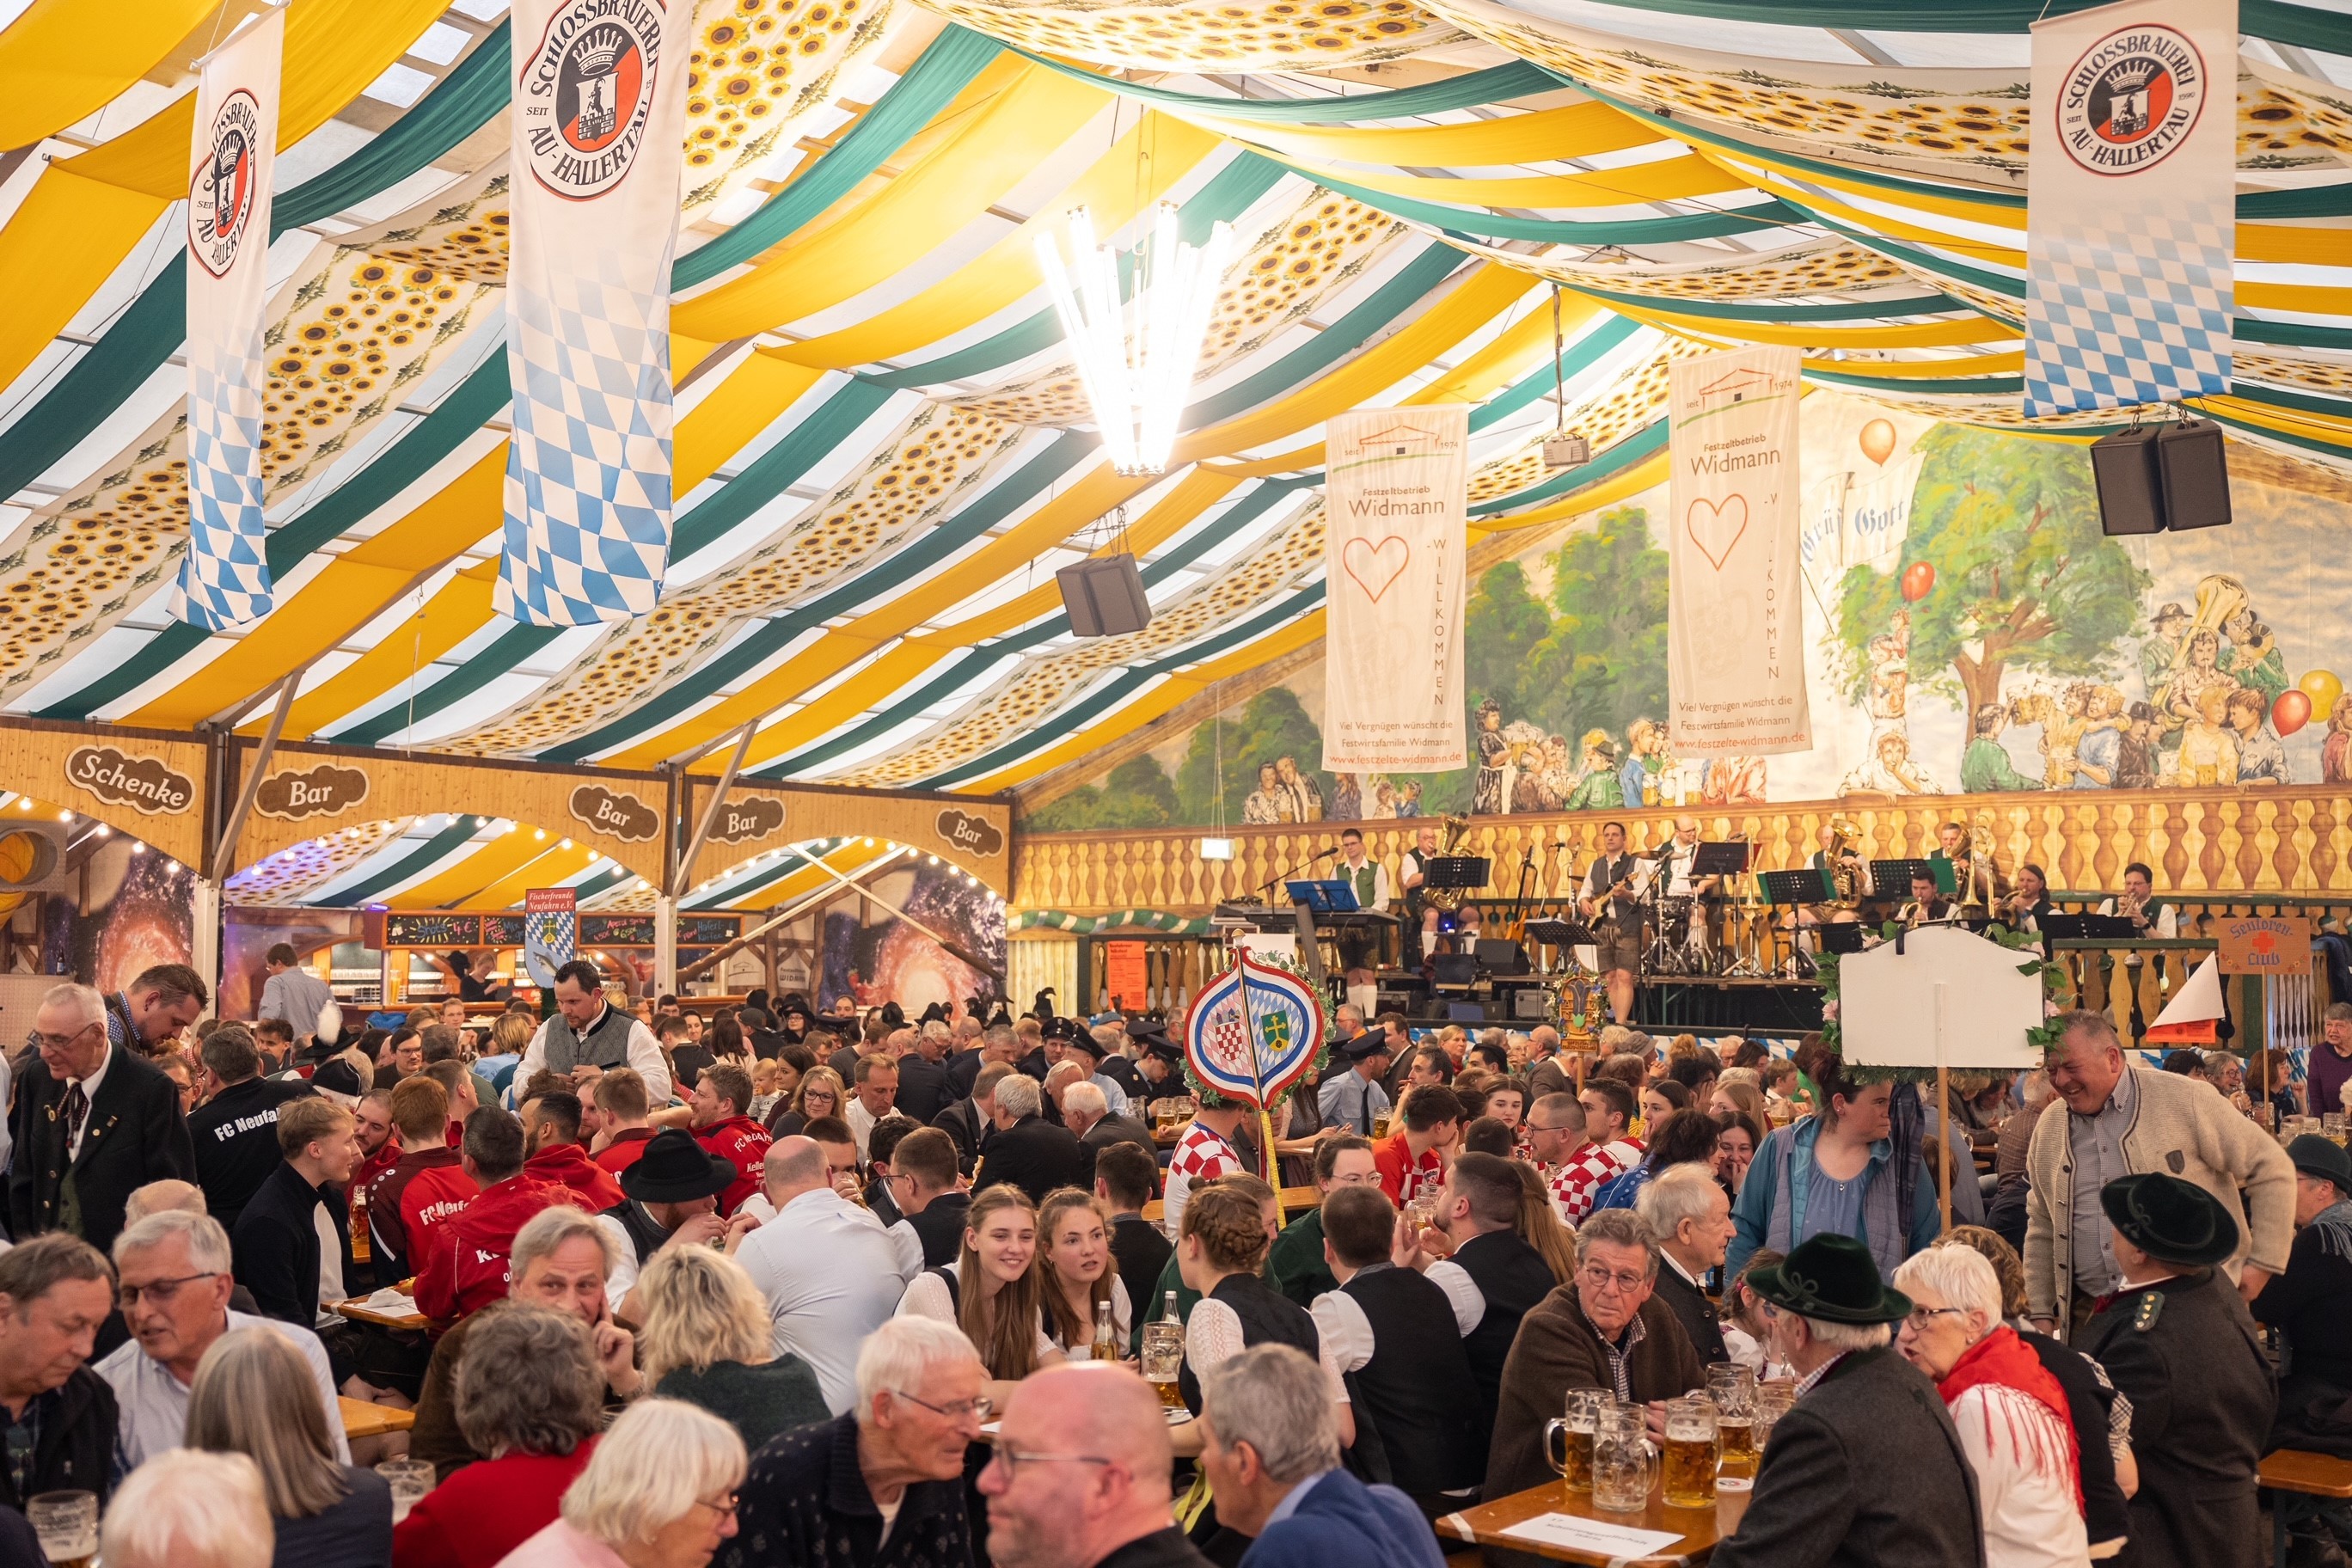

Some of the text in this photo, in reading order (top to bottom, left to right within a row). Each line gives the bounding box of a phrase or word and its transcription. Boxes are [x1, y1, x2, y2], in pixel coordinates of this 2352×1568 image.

[2067, 34, 2196, 109] SCHLOSSBRAUEREI
[526, 107, 549, 116] SEIT
[2067, 91, 2196, 125] SEIT 1590
[2068, 106, 2190, 167] AU-HALLERTAU
[1686, 379, 1792, 409] seit 1974
[1344, 441, 1459, 456] seit 1974
[1703, 433, 1767, 452] Festzeltbetrieb
[1691, 449, 1781, 476] Widmann
[1363, 485, 1430, 497] Festzeltbetrieb
[1349, 498, 1445, 517] Widmann
[1679, 695, 1792, 714] Viel Vergnügen wünscht die
[1339, 720, 1453, 732] Viel Vergnügen wünscht die
[1681, 716, 1791, 731] Festwirtsfamilie Widmann
[1342, 738, 1450, 748] Festwirtsfamilie Widmann
[1674, 732, 1806, 750] www.festzelte-widmann.de
[1329, 751, 1461, 765] www.festzelte-widmann.de
[77, 754, 185, 806] Schenke
[288, 781, 334, 806] Bar
[596, 798, 631, 827] Bar
[727, 812, 757, 834] Bar
[953, 818, 982, 843] Bar
[529, 891, 573, 902] Fischerfreunde
[528, 901, 560, 912] Neufahrn
[416, 922, 448, 939] Shots
[2229, 917, 2294, 940] Senioren-
[2248, 952, 2281, 966] Club
[213, 1123, 236, 1142] FC
[734, 1137, 746, 1153] FC
[419, 1205, 436, 1226] FC
